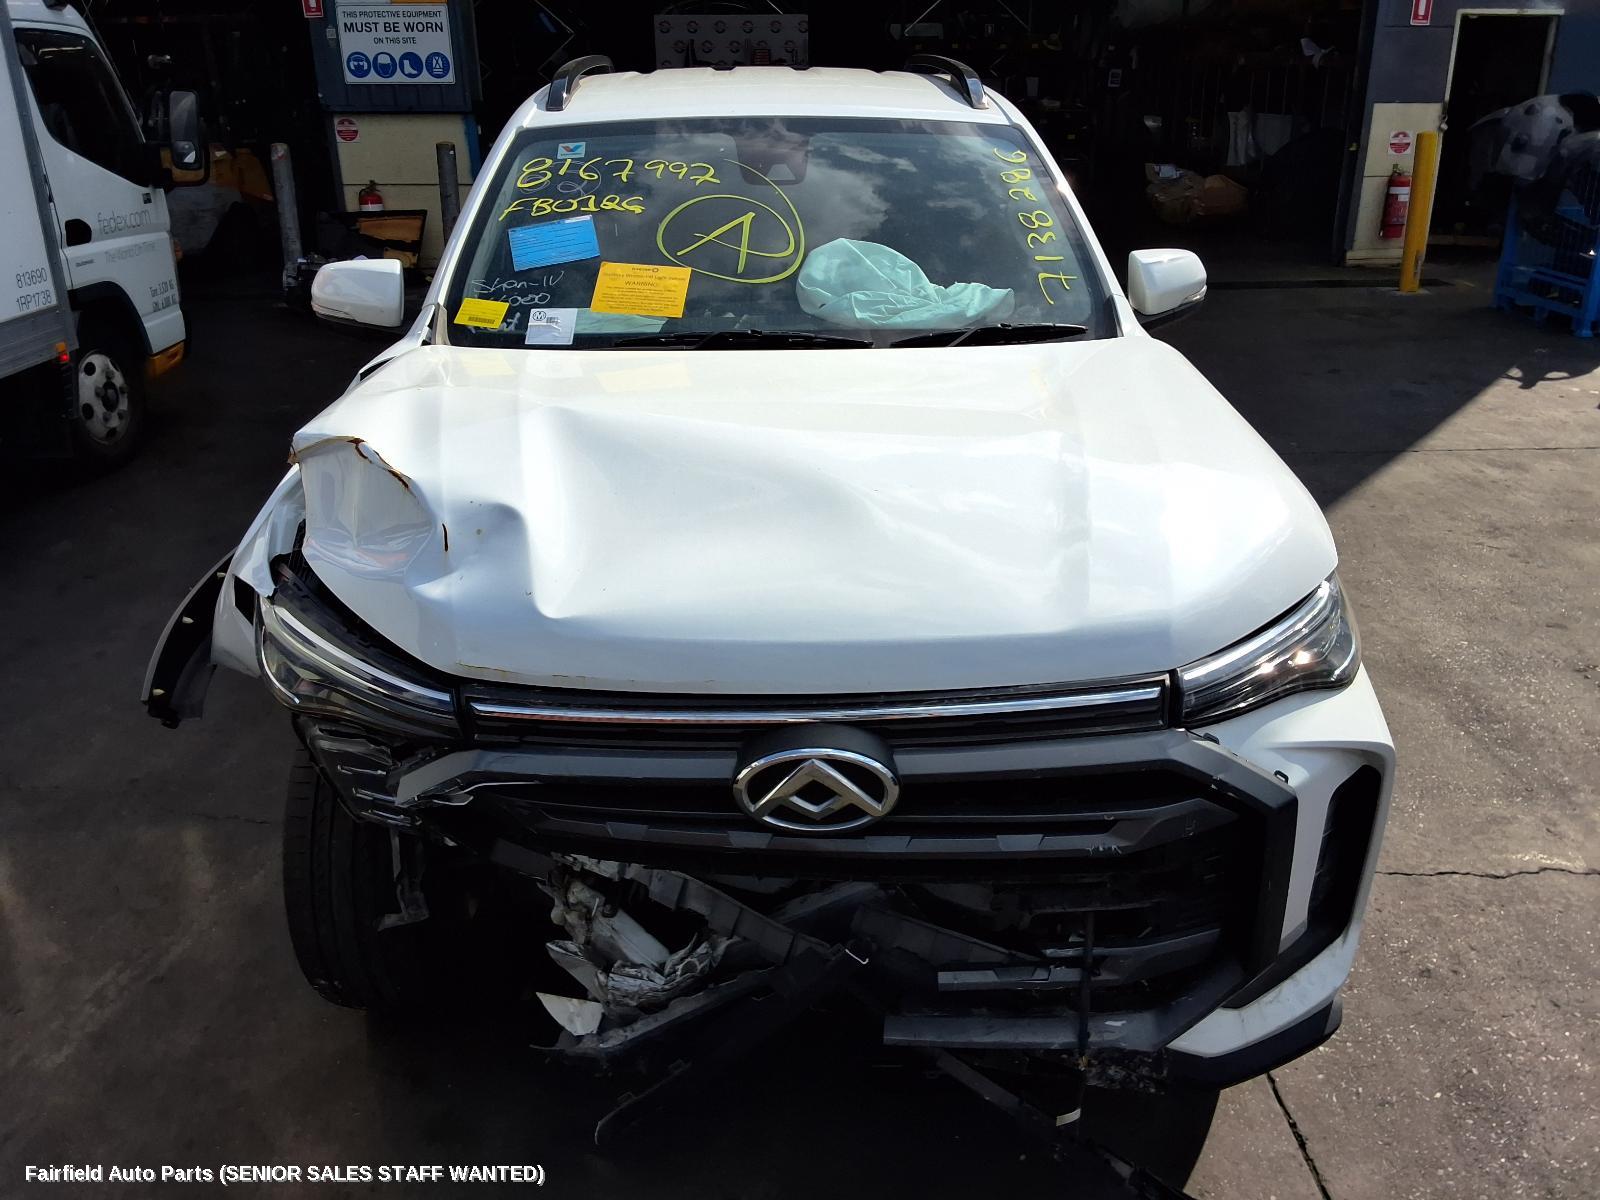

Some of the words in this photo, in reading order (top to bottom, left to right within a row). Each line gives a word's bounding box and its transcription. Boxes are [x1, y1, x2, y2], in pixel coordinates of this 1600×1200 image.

[342, 10, 358, 18] THIS
[359, 10, 401, 18] PROTECTIVE
[402, 10, 442, 18] EQUIPMENT
[343, 21, 379, 33] MUST
[383, 21, 401, 33] BE
[403, 21, 444, 33] WORN
[373, 36, 384, 45] ON
[386, 36, 401, 45] THIS
[401, 36, 417, 45] SITE
[516, 157, 721, 188] 8167992
[97, 208, 151, 235] fedex.com
[993, 147, 1078, 305] 7138286
[16, 267, 48, 289] 813690
